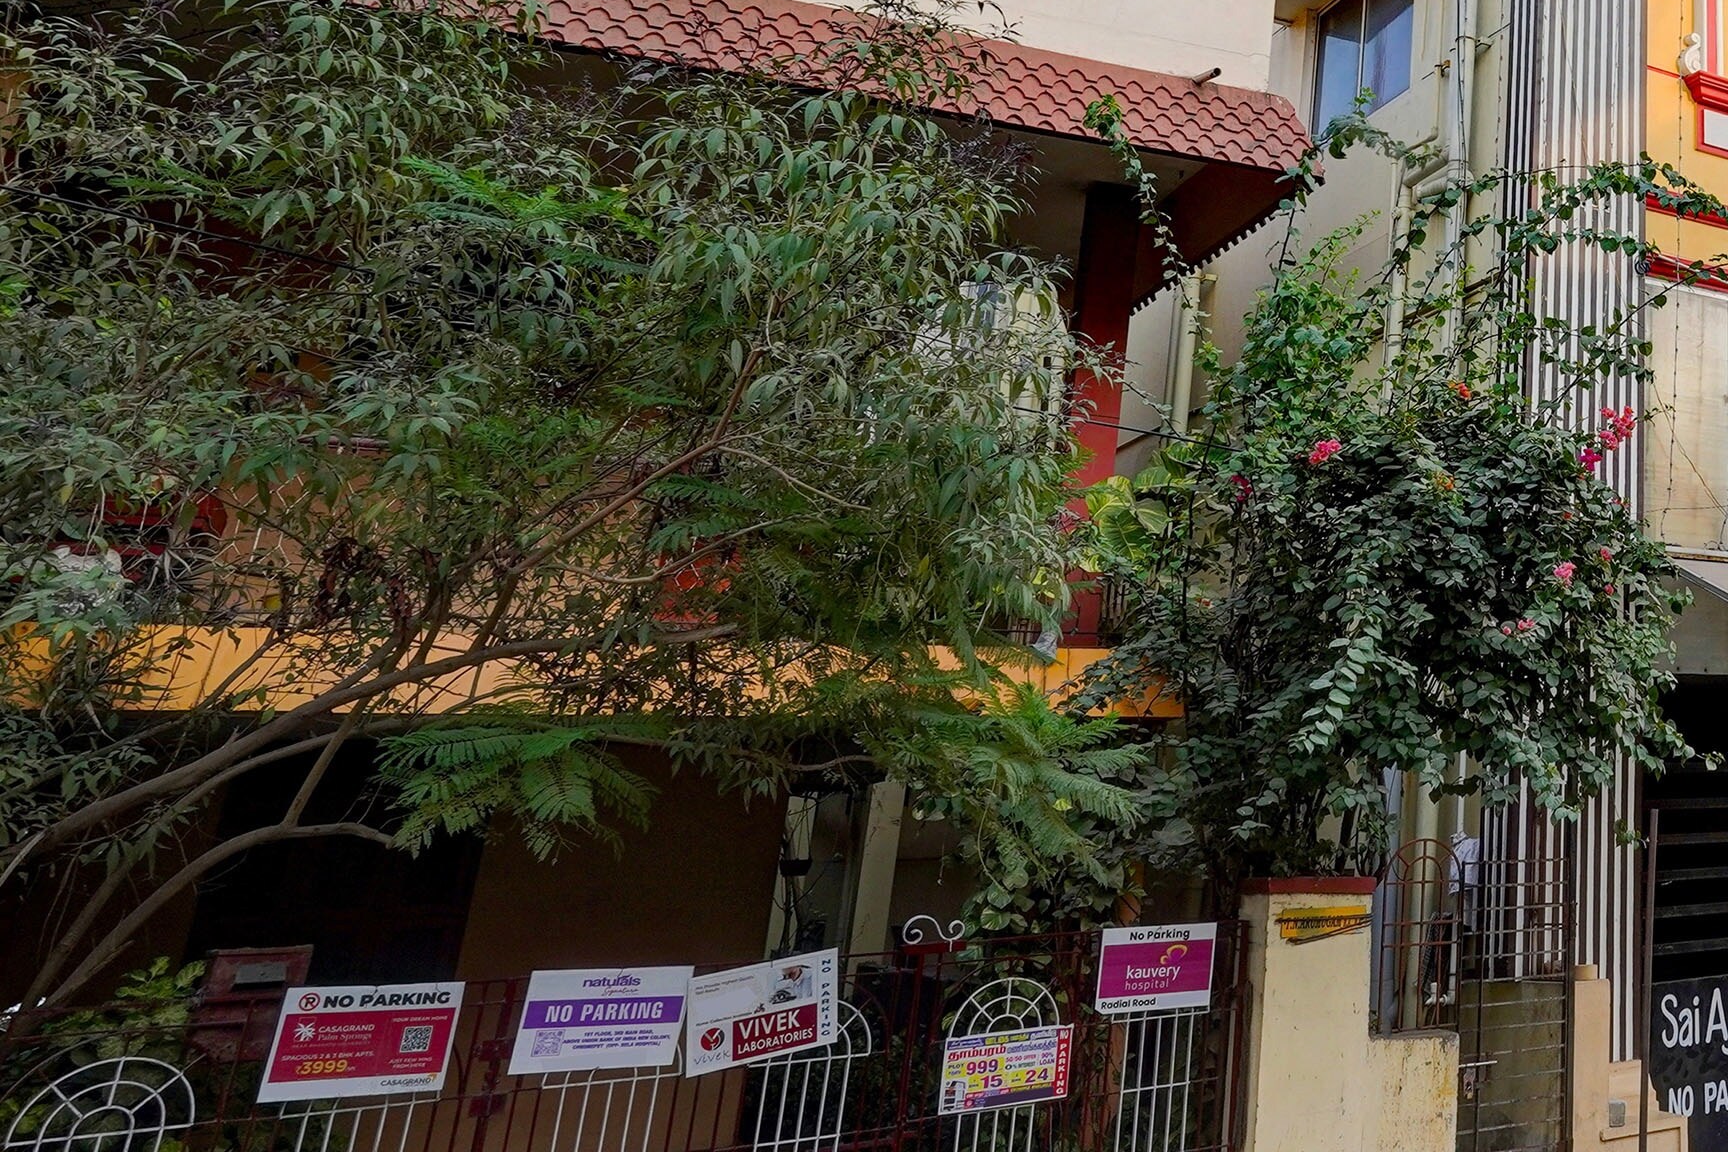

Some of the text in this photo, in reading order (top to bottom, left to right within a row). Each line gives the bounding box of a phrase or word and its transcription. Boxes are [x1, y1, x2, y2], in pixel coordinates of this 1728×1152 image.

[1130, 929, 1190, 940] No Parking
[821, 959, 831, 973] NO
[1126, 965, 1180, 980] kauvery
[582, 974, 641, 988] naturals
[1125, 979, 1169, 991] hospital
[323, 991, 451, 1009] NO PARKING
[1101, 998, 1156, 1009] Radial Road
[544, 1001, 664, 1023] NO PARKING
[821, 983, 831, 1036] PARKING
[738, 1009, 801, 1040] VIVEK
[1661, 994, 1700, 1048] Sai
[317, 1031, 372, 1042] Palm Springs
[318, 1024, 375, 1034] CASAGRAND
[1059, 1029, 1068, 1041] NO
[737, 1028, 813, 1055] LABORATORIES
[281, 1054, 318, 1062] SPACIOUS
[947, 1043, 1006, 1063] தாம்பரம்
[966, 1059, 998, 1075] 999
[1055, 1043, 1067, 1094] PARKING
[981, 1075, 1002, 1089] 15
[1025, 1068, 1048, 1084] 24
[1668, 1085, 1694, 1117] NO
